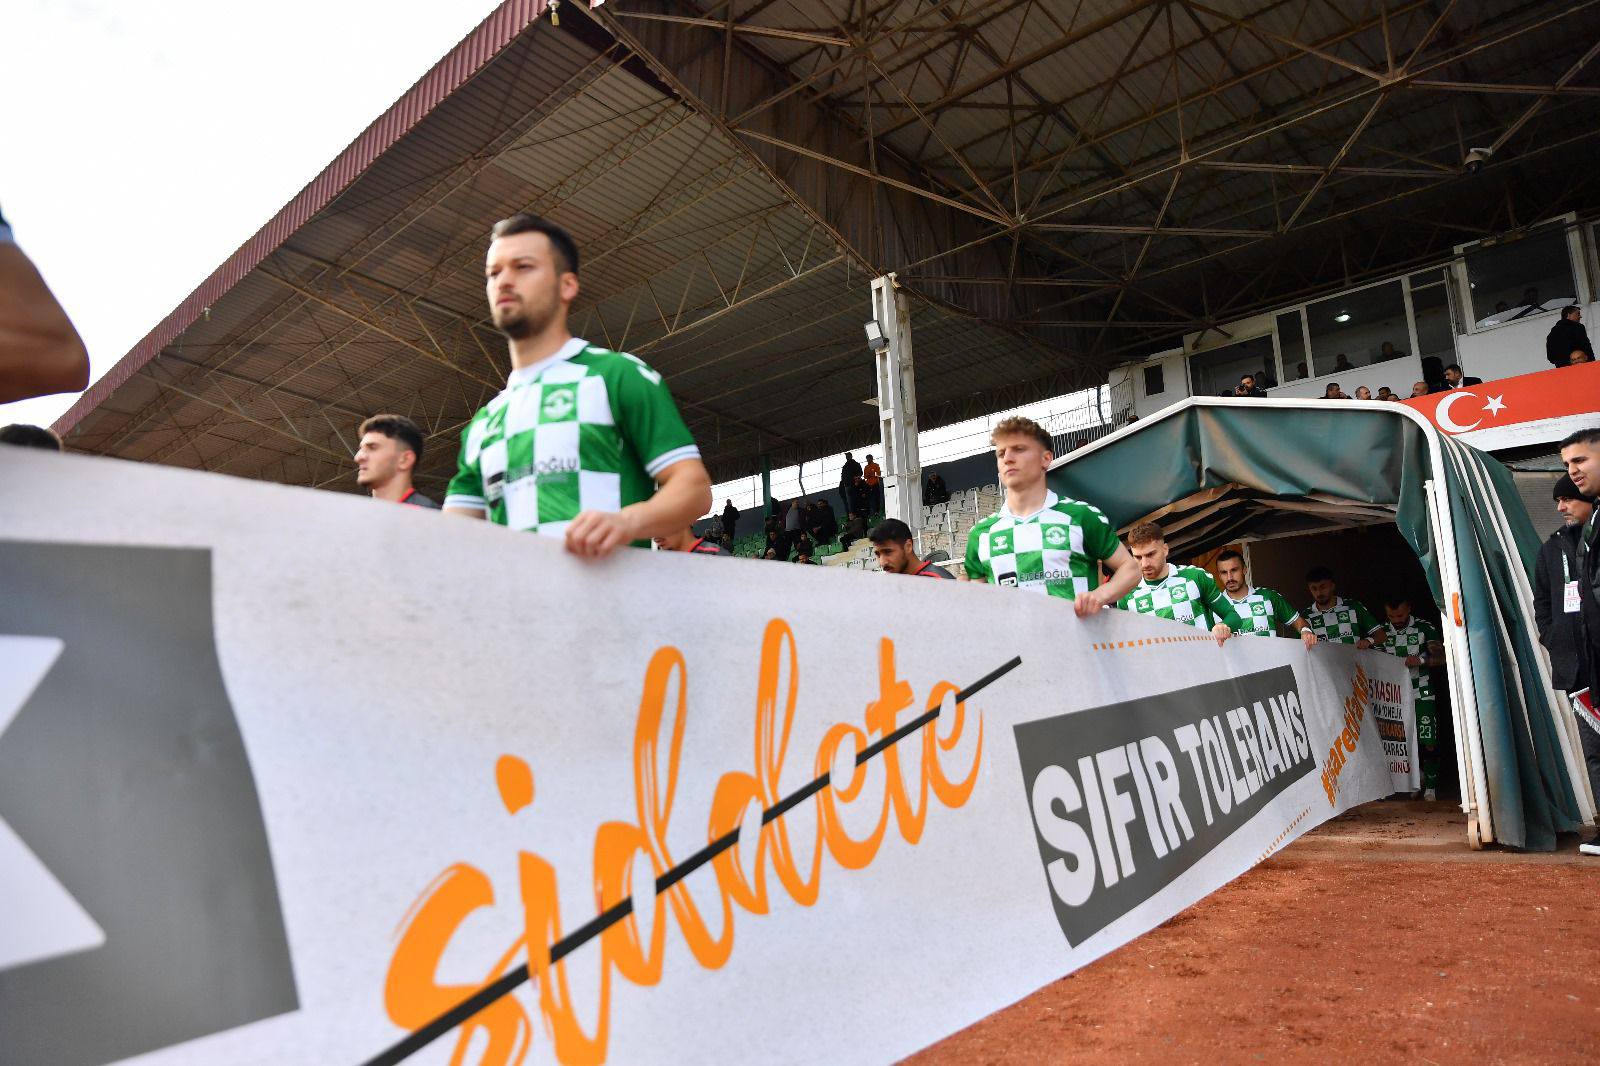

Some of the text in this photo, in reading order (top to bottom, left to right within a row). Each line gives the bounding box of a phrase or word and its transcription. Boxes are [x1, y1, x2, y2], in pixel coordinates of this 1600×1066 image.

[1420, 725, 1431, 738] 23
[1032, 690, 1309, 907] SIFIR TOLERANS
